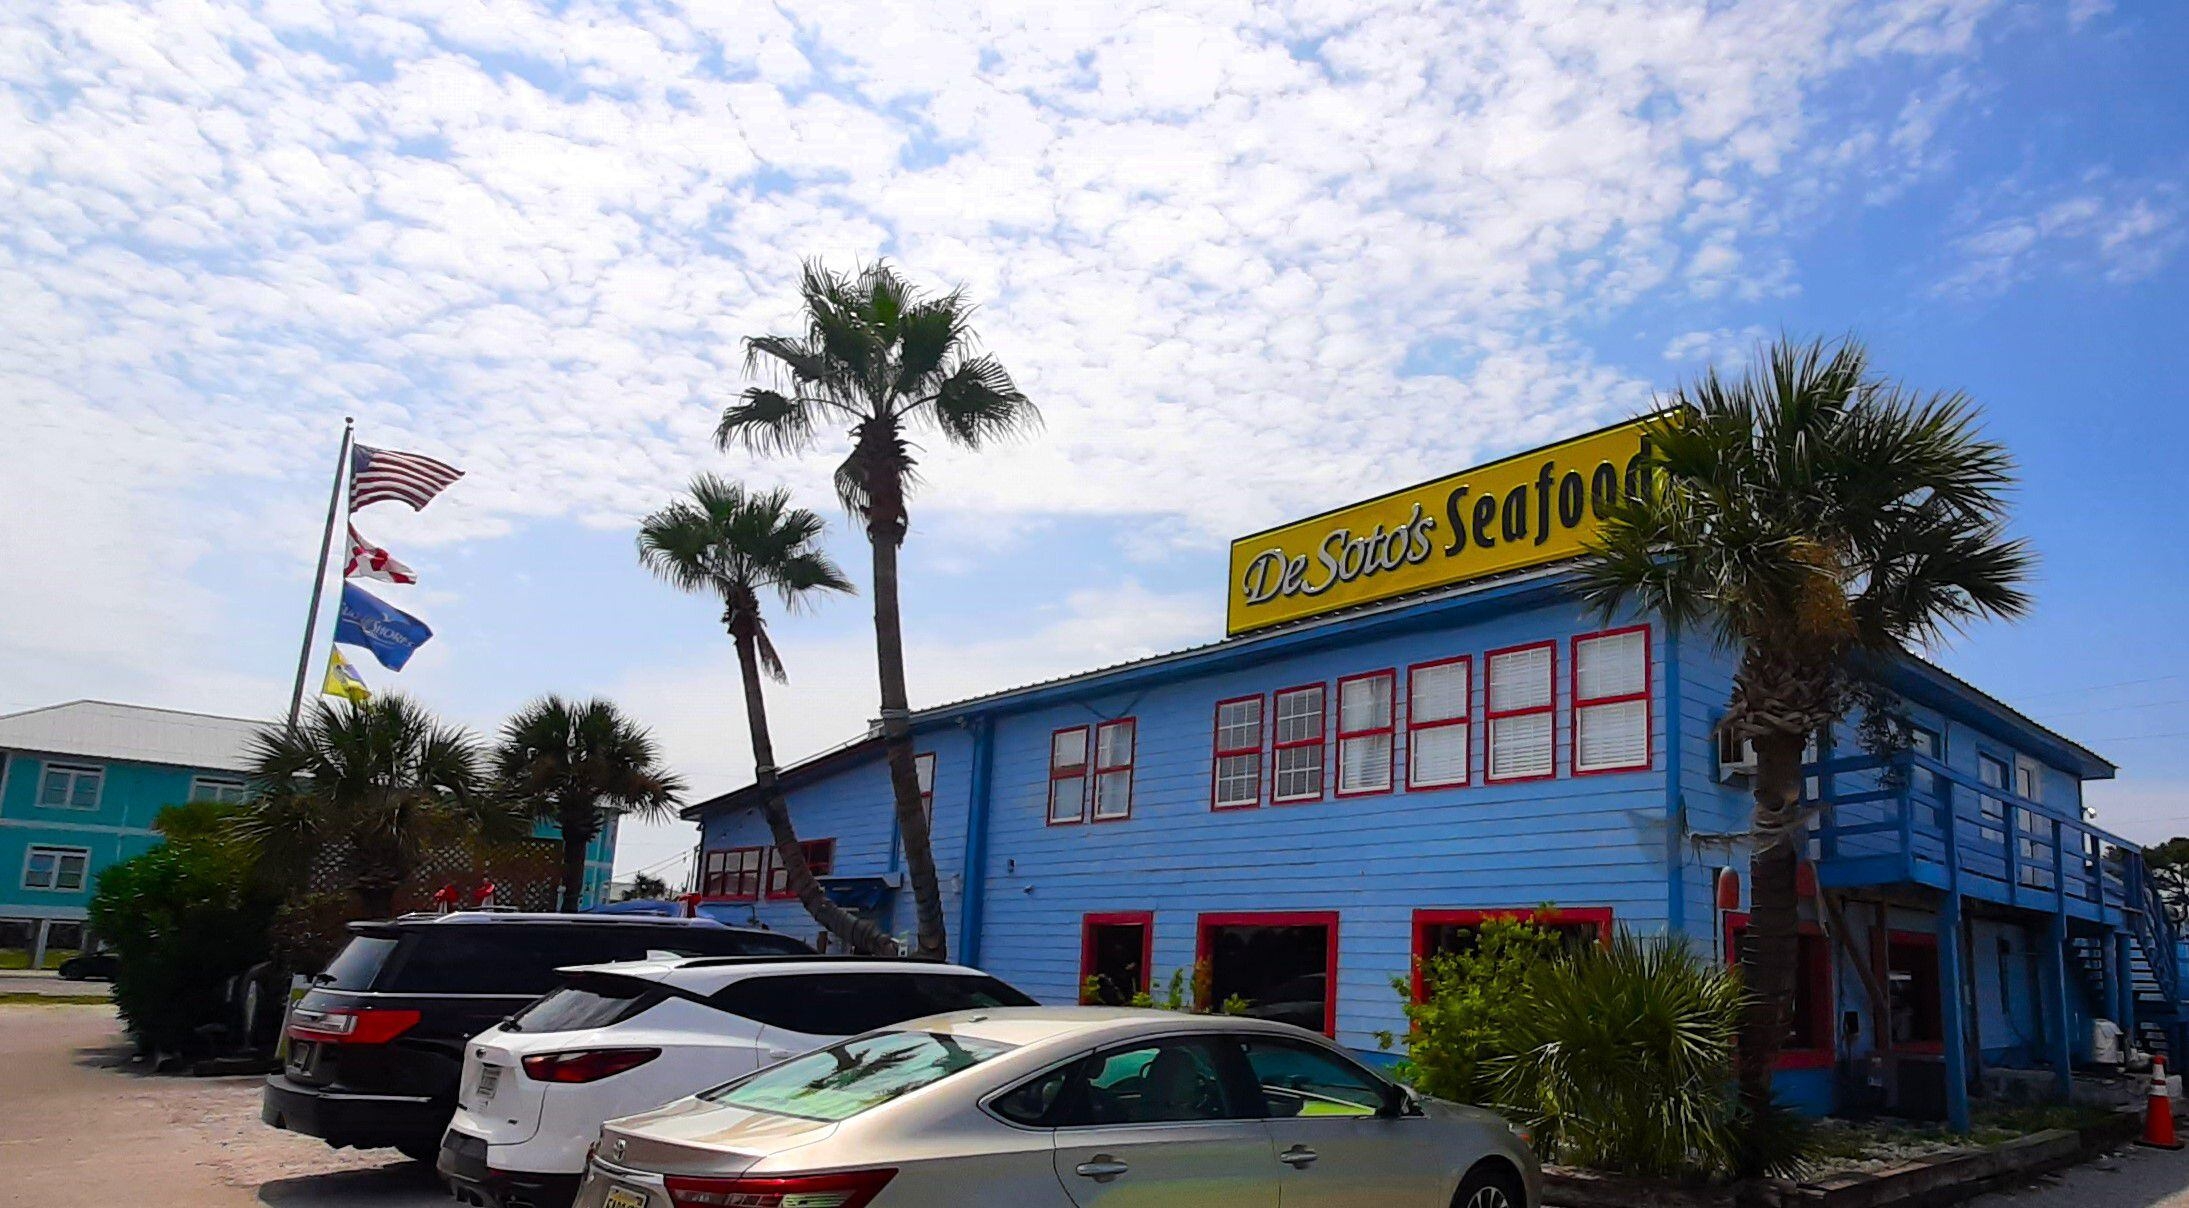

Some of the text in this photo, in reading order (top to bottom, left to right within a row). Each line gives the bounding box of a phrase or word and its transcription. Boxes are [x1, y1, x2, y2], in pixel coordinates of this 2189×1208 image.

[1242, 432, 1652, 606] De Soto's Seafood
